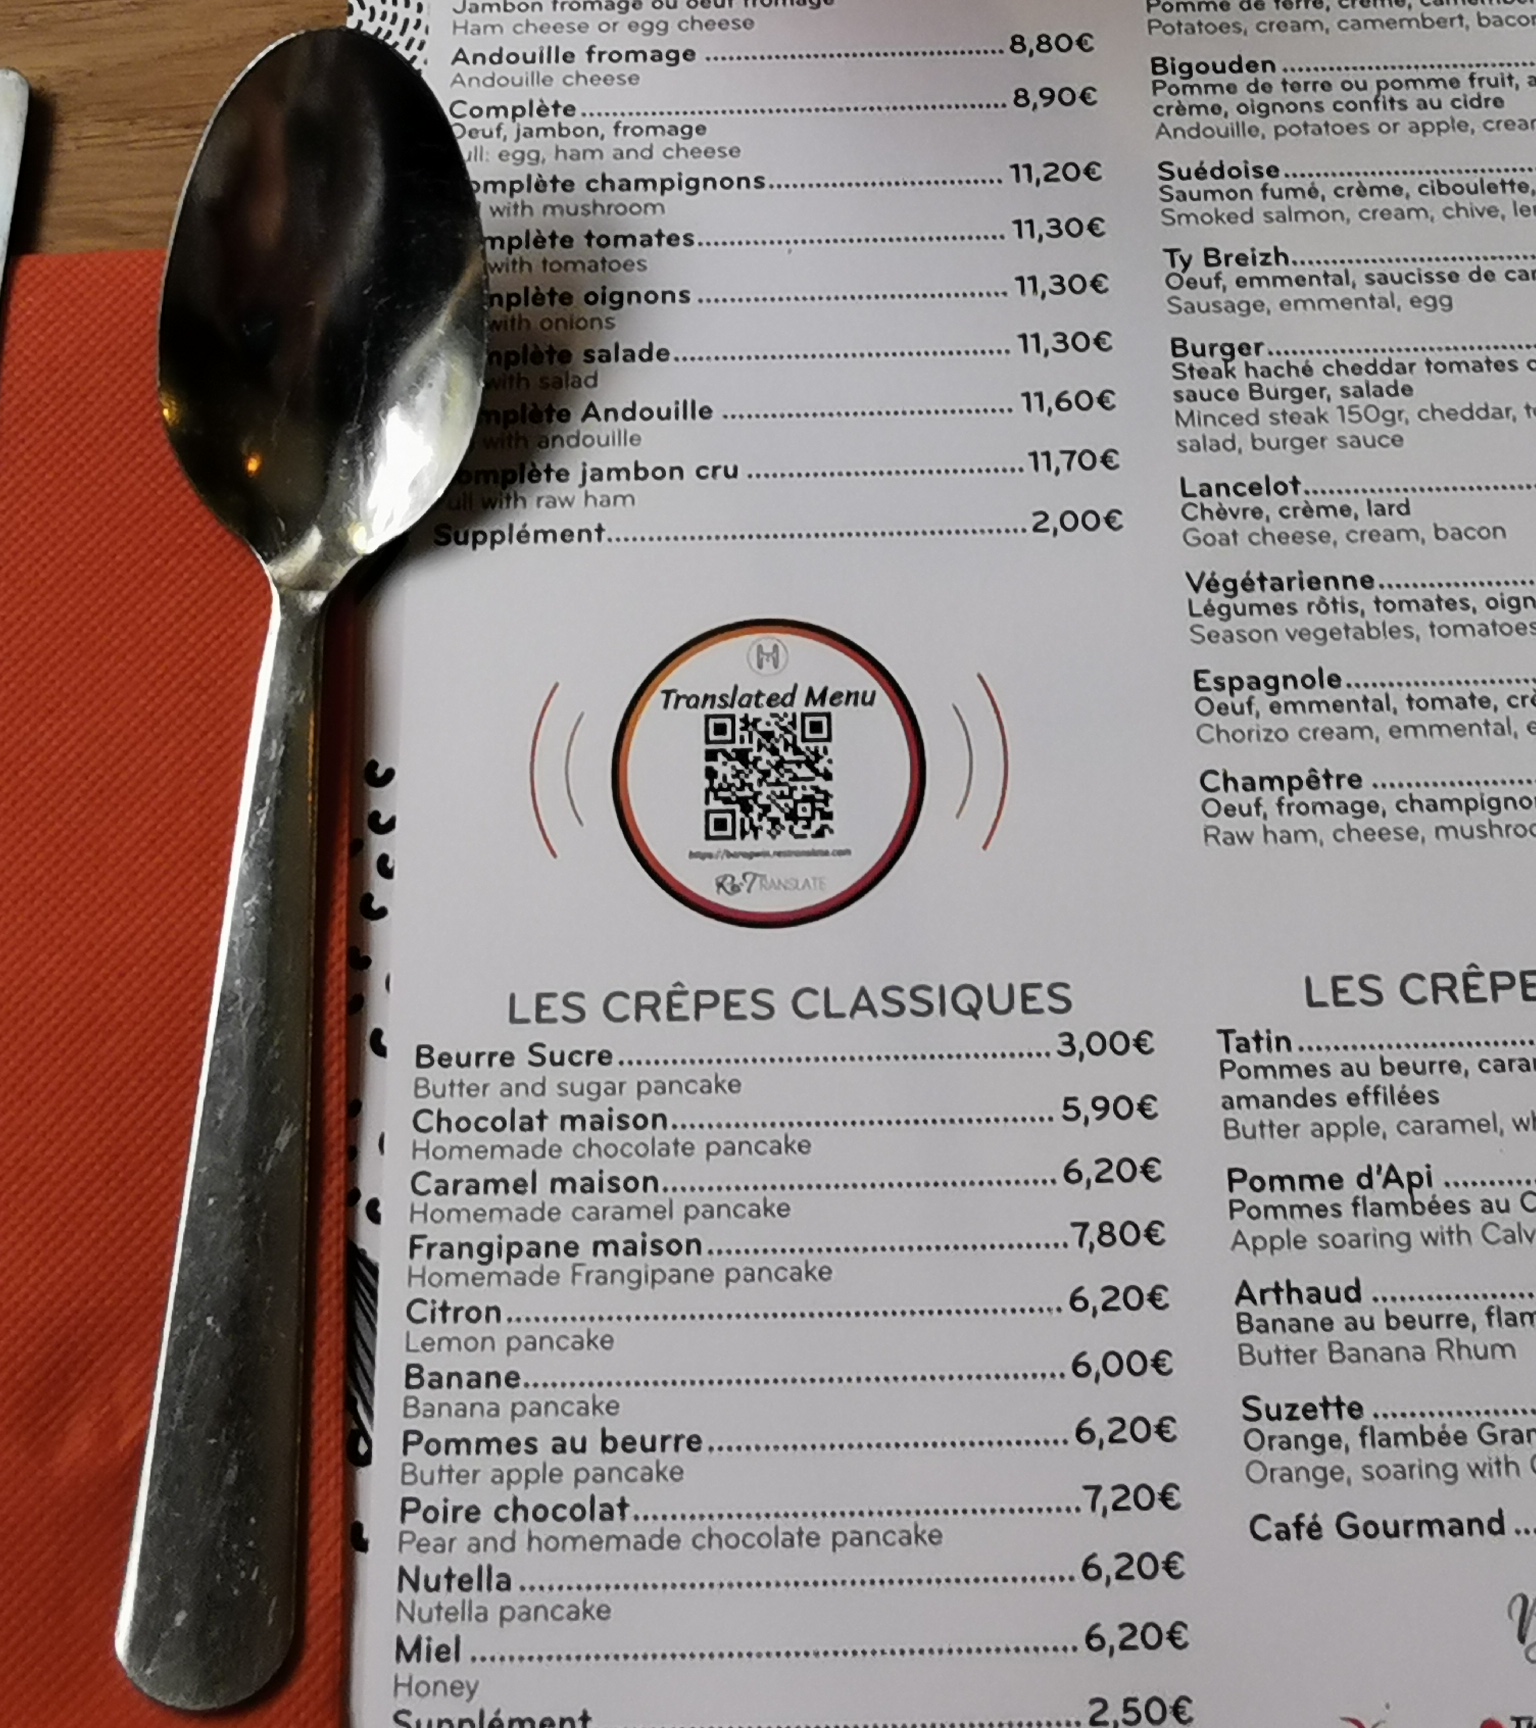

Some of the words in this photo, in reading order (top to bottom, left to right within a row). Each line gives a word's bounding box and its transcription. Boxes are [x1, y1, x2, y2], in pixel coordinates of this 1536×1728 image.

[451, 45, 575, 65] Andouille
[586, 45, 696, 67] fromage
[1010, 33, 1094, 57] 8,80€
[450, 98, 576, 123] Complète
[1013, 87, 1097, 111] 8,90€
[1180, 475, 1301, 498] Lancelot
[433, 523, 606, 552] Supplément
[1032, 509, 1123, 537] 2,00€
[660, 684, 799, 710] Translated
[804, 683, 876, 707] Menu
[1200, 768, 1362, 797] Champêtre
[509, 991, 586, 1024] LES
[603, 981, 775, 1023] CRÊPES
[791, 982, 1072, 1021] CLASSIQUES
[1305, 974, 1383, 1008] LES
[416, 1044, 515, 1069] Beurre
[528, 1043, 612, 1067] Sucre
[1057, 1030, 1154, 1062] 3,00€
[1216, 1029, 1292, 1054] Tatin
[414, 1077, 490, 1099] Butter
[500, 1076, 546, 1097] and
[557, 1081, 626, 1102] sugar
[637, 1072, 741, 1101] pancake
[413, 1107, 548, 1133] Chocolat
[560, 1107, 667, 1132] maison
[1062, 1094, 1158, 1127] 5,90€
[406, 1298, 501, 1324] Citron
[1069, 1285, 1169, 1318] 6,20€
[1235, 1277, 1361, 1306] Arthaud
[1242, 1395, 1363, 1422] Suzette
[1250, 1513, 1323, 1541] Café
[1335, 1508, 1505, 1539] Gourmand
[398, 1564, 511, 1593] Nutella
[1082, 1552, 1185, 1587] 6,20€
[396, 1634, 460, 1663] Miel
[1085, 1622, 1189, 1658] 6,20€
